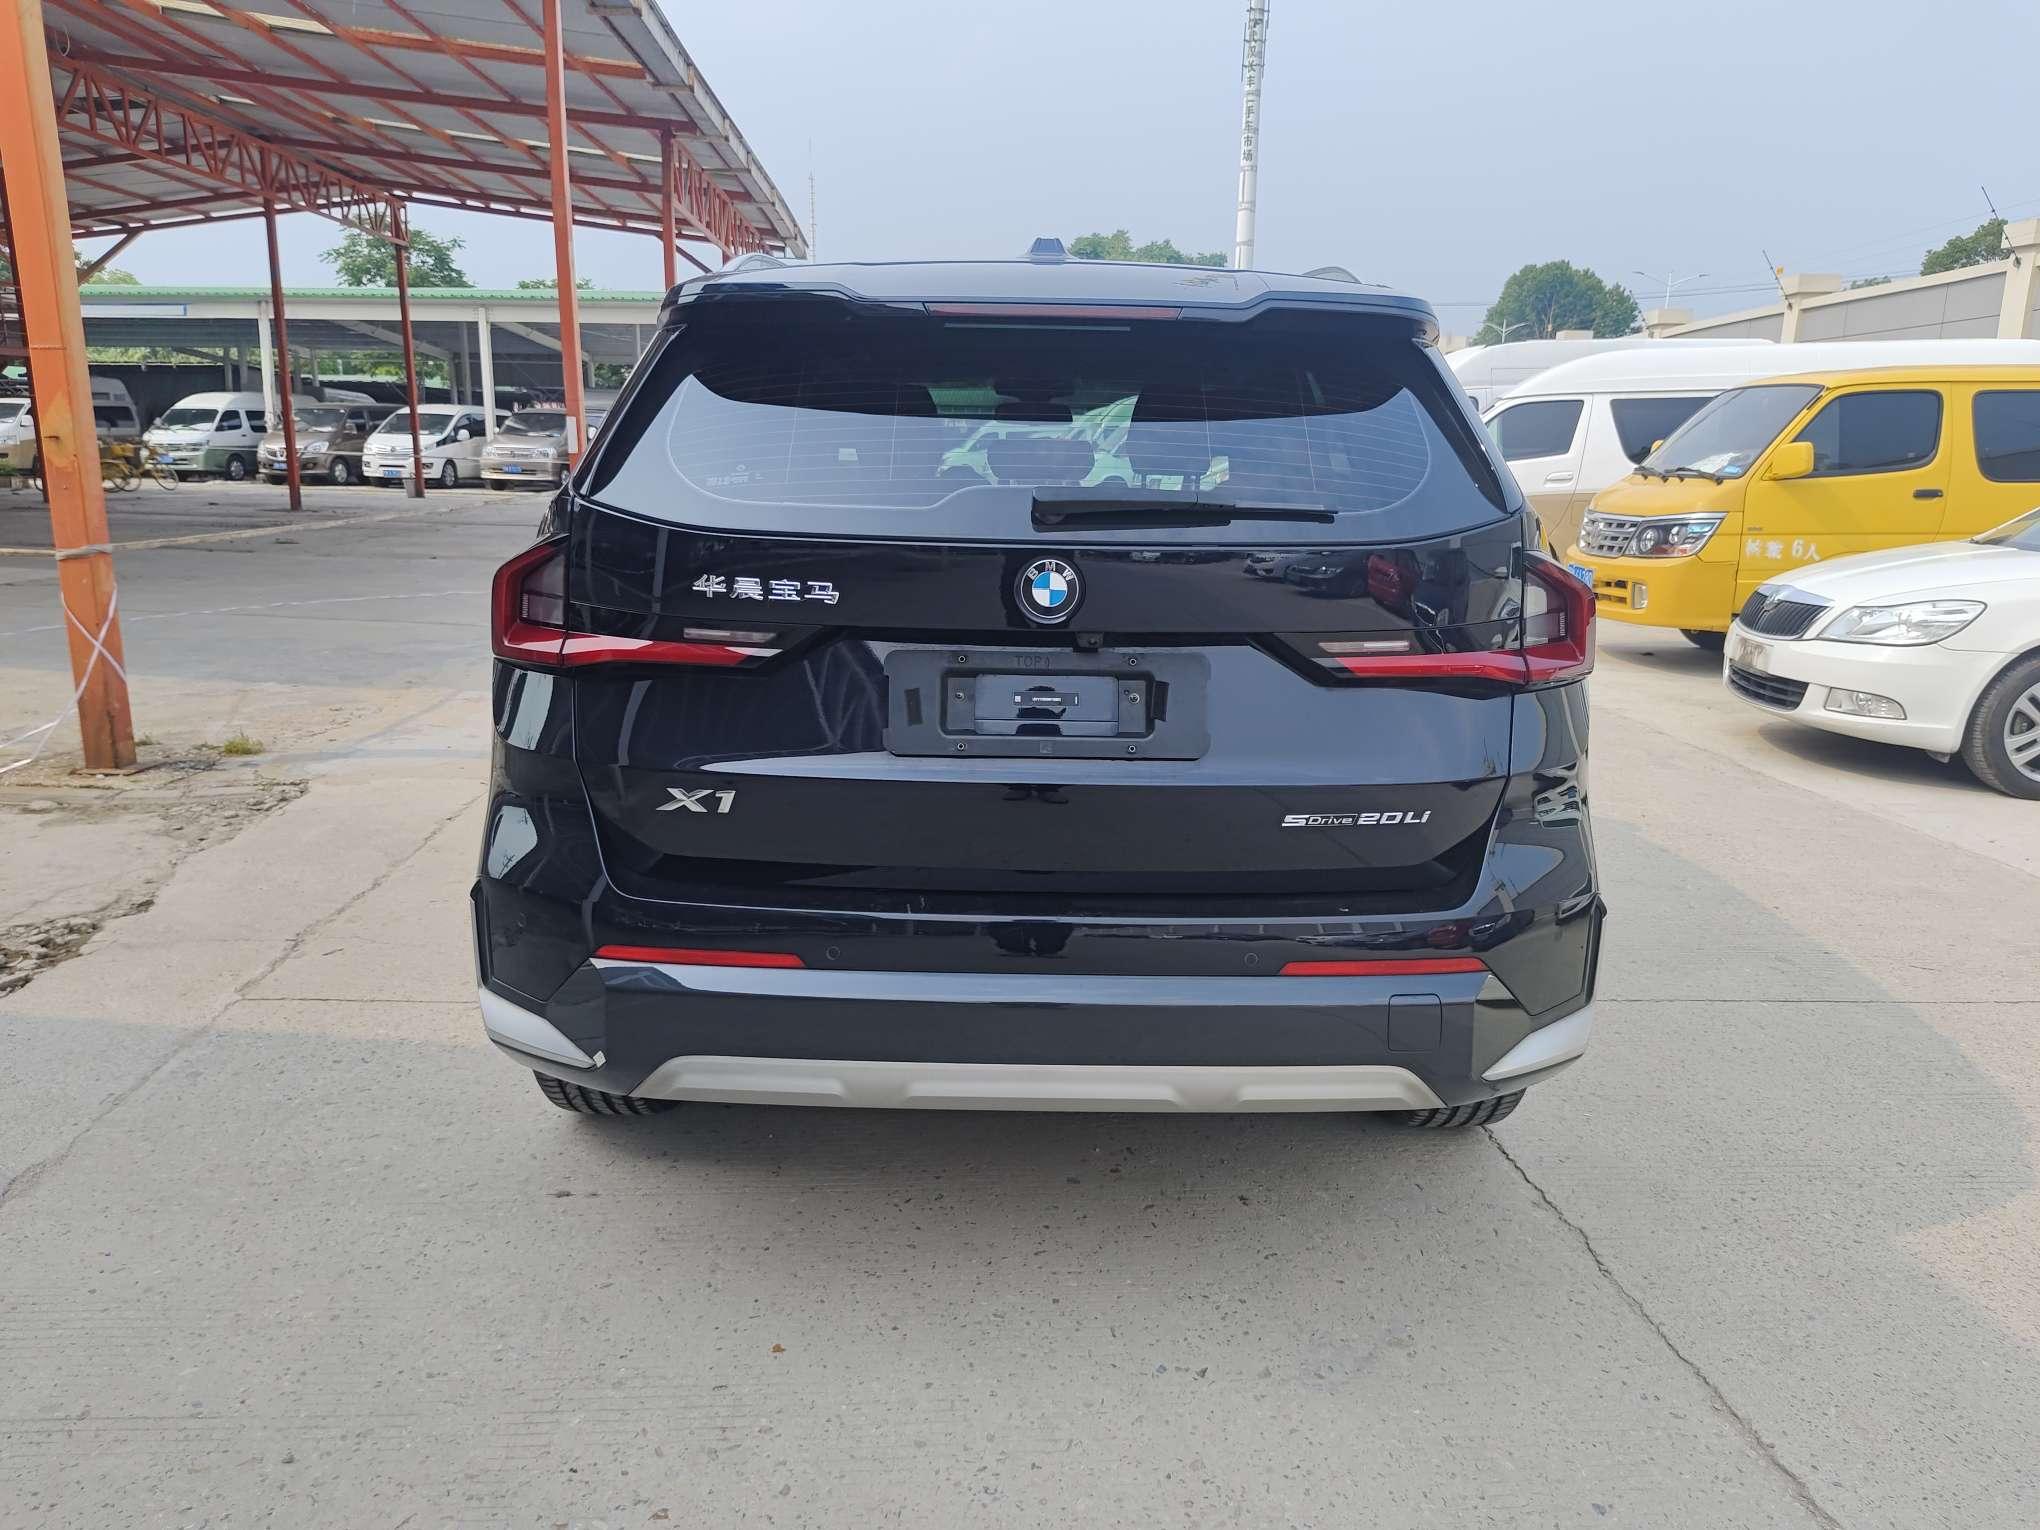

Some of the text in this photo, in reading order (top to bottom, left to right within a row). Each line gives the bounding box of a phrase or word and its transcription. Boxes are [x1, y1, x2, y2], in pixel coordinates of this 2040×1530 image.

[1026, 561, 1075, 581] BMW
[692, 573, 840, 605] 华晨宝马
[1014, 655, 1042, 668] TOP
[655, 787, 737, 813] X1
